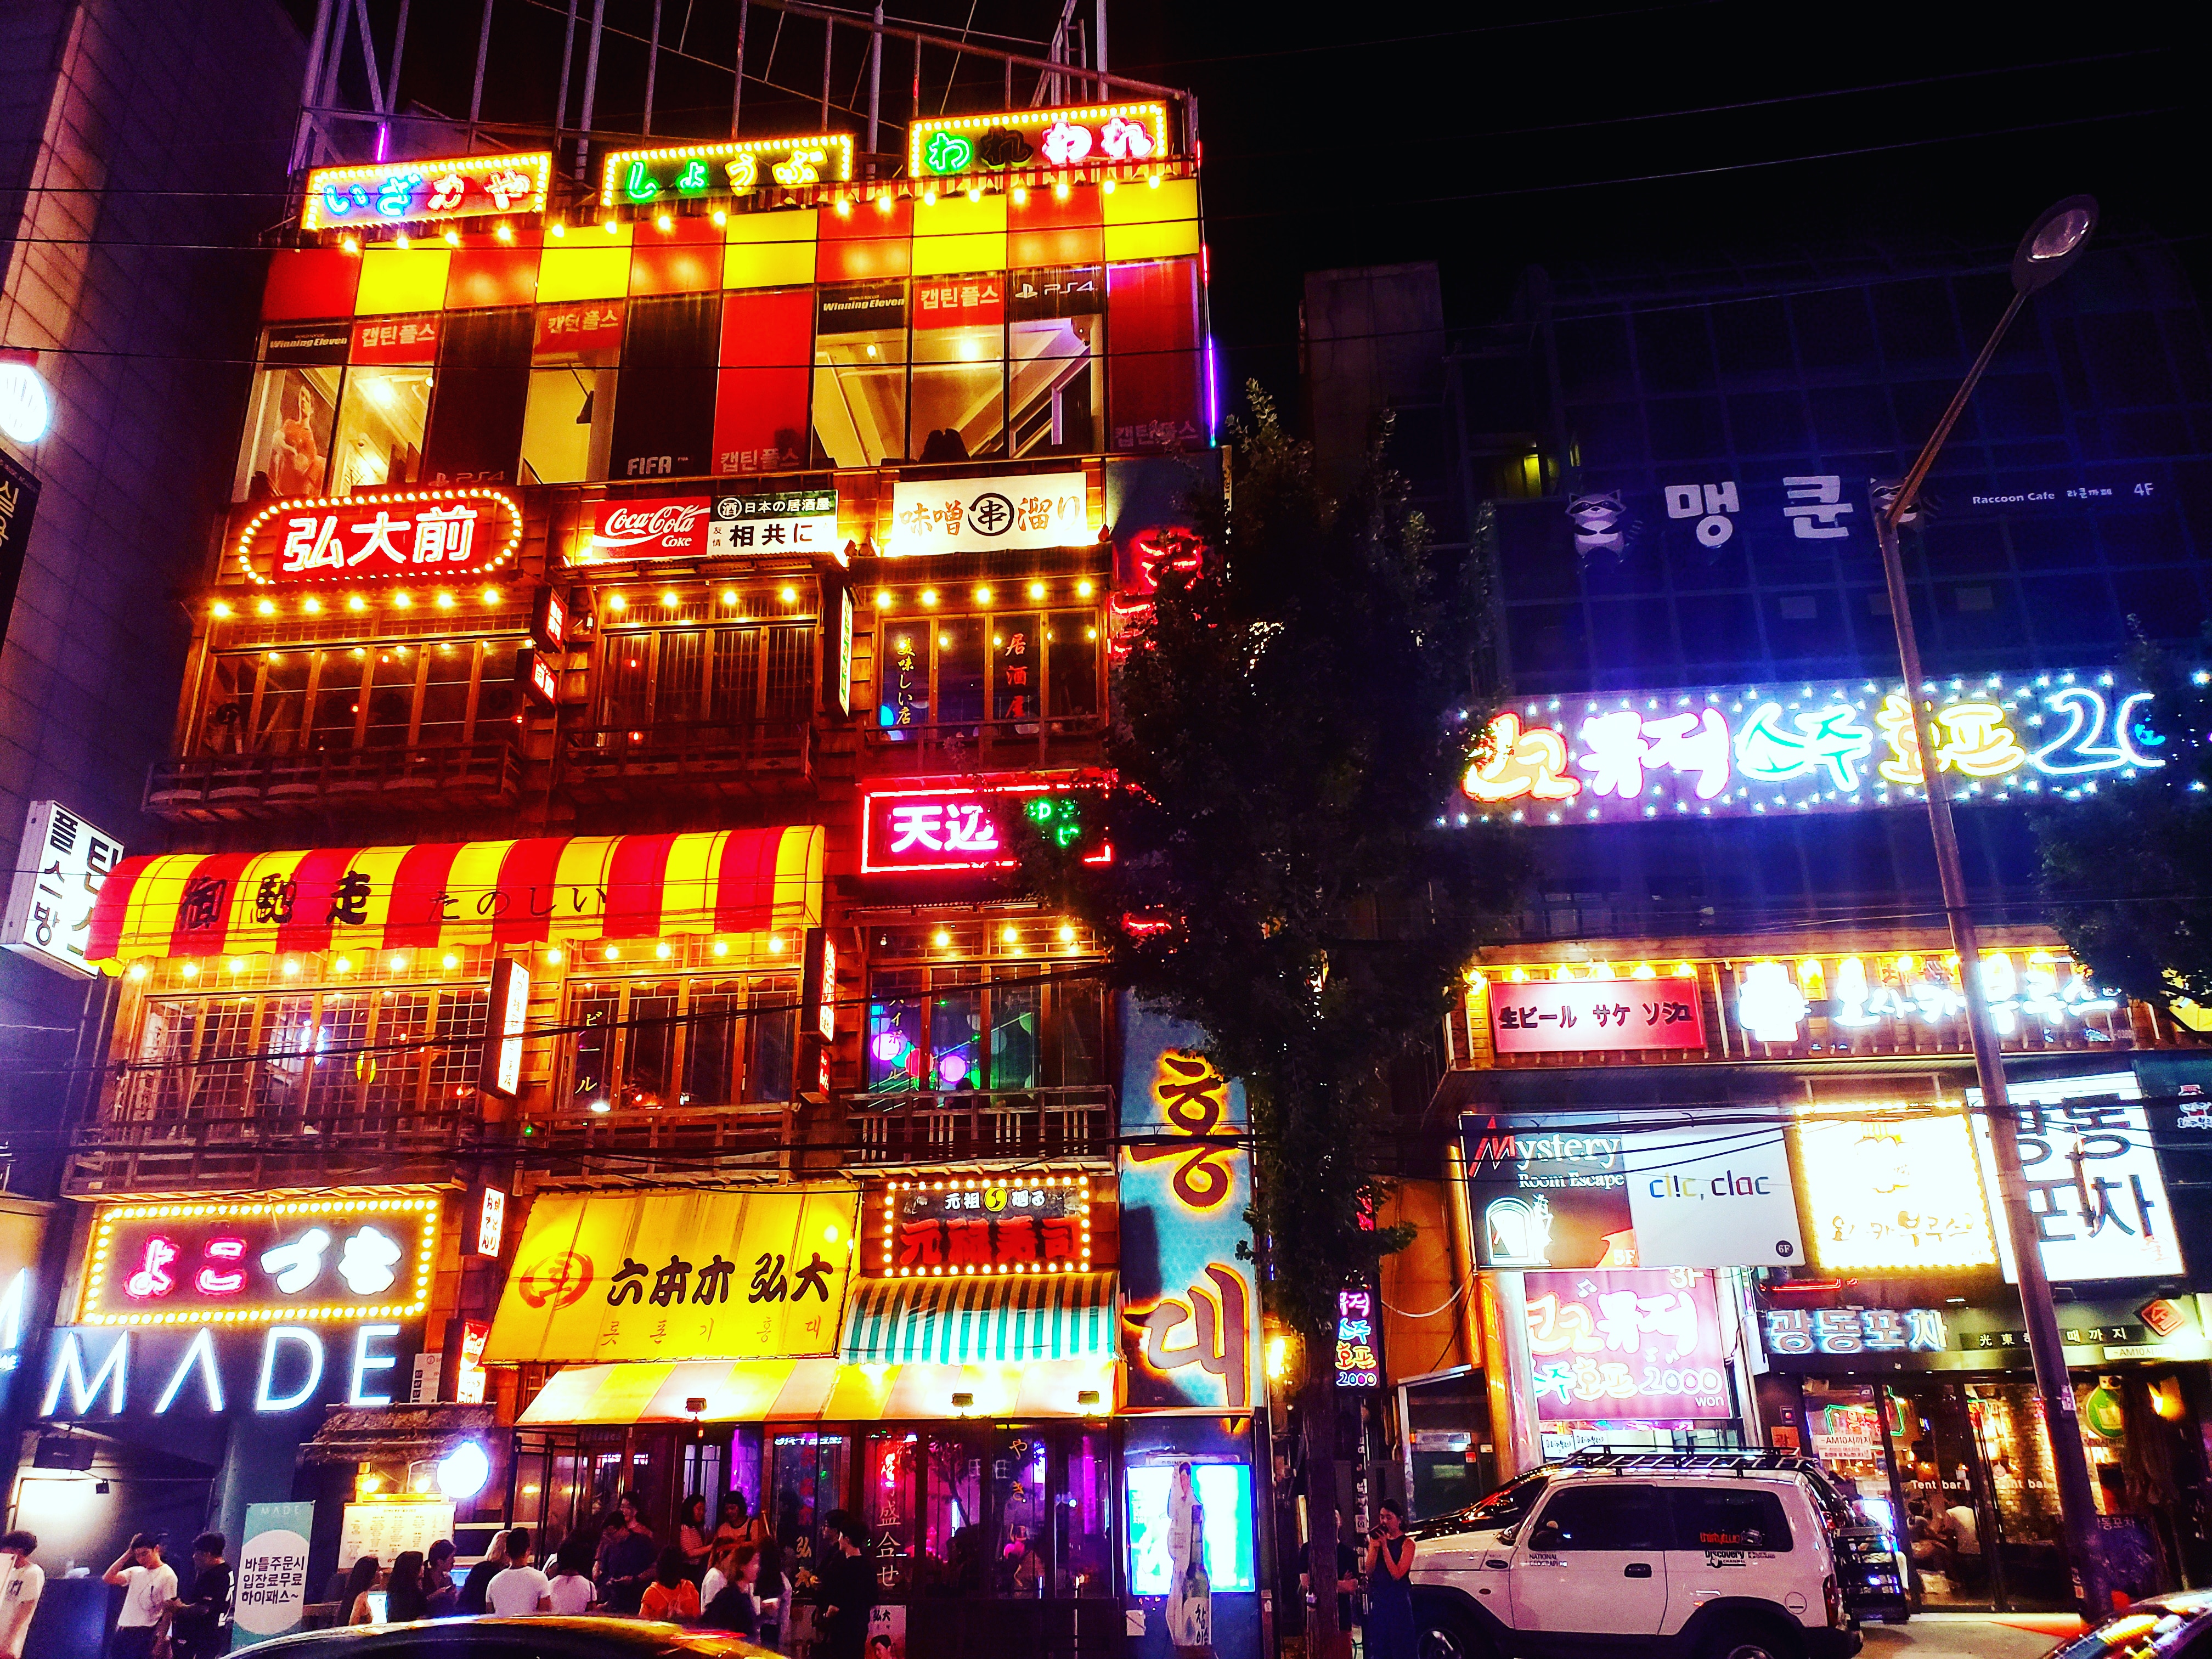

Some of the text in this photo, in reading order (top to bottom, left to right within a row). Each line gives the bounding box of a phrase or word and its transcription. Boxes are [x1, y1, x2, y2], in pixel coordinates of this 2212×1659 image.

[626, 148, 827, 202] しょうぶ
[324, 169, 532, 217] いざかや
[1044, 280, 1094, 294] PS4
[823, 298, 905, 311] Winning Eleven
[270, 337, 314, 349] Winning
[627, 456, 672, 476] FIFA
[744, 496, 830, 514] 日本の居酒屋
[1973, 493, 2024, 504] Raccoon
[2028, 491, 2055, 501] Cafe
[2134, 482, 2154, 496] 4F
[605, 505, 704, 535] Coca-Cola
[283, 504, 477, 573] 弘大前
[662, 534, 692, 548] Coke
[729, 522, 813, 548] 相共に
[896, 637, 916, 726] 美味しい店
[1005, 633, 1027, 718] 居酒屋
[33, 810, 78, 946] 플스방
[428, 885, 608, 921] たのしい
[1499, 1006, 1578, 1029] 生ビール
[1593, 1003, 1631, 1027] サケ
[575, 1011, 603, 1093] ビール
[1469, 1116, 1622, 1178] Mystery
[1518, 1172, 1625, 1190] Room Escape
[1711, 1170, 1771, 1197] clac
[945, 1192, 980, 1210] 元祖
[1613, 1249, 1636, 1266] 5F
[1778, 1244, 1792, 1254] 6F
[748, 1252, 833, 1304] 弘大
[1769, 1308, 1949, 1354] 광동포차
[41, 1324, 401, 1418] MADE
[1336, 1372, 1377, 1387] 2000
[1638, 1367, 1723, 1396] 2000
[1695, 1396, 1725, 1407] won
[1911, 1480, 1961, 1489] Tent bar
[260, 1504, 301, 1515] MADE
[1705, 1550, 1745, 1560] Discovery
